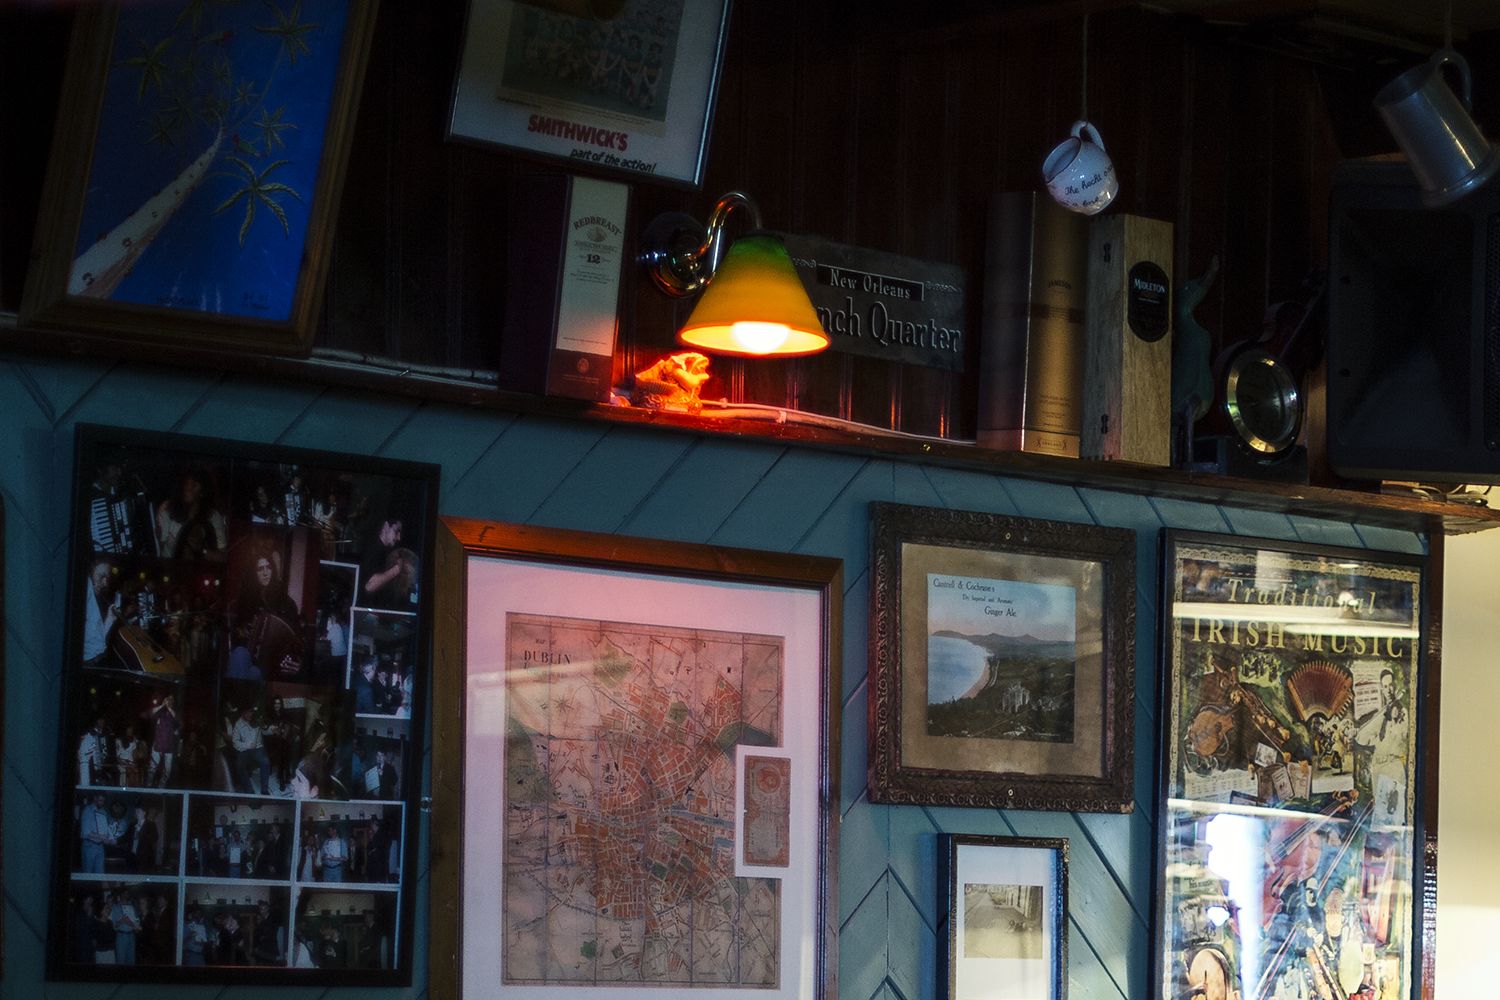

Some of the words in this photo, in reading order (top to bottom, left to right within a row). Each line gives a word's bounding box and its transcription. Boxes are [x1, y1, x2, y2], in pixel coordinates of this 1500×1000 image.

[527, 114, 629, 152] SMITHWICK'S
[570, 148, 592, 161] part
[592, 151, 606, 161] of
[604, 153, 620, 166] the
[620, 159, 657, 173] action!
[573, 215, 622, 236] REDBREAST
[587, 253, 601, 264] 12
[830, 268, 857, 290] New
[862, 274, 913, 300] Orleans
[817, 296, 862, 337] nch
[871, 301, 962, 353] Quarter
[1227, 578, 1376, 615] Traditional
[1006, 608, 1017, 617] Ale
[1191, 616, 1286, 649] IRISH
[1303, 633, 1403, 658] MUSIC
[524, 649, 573, 665] DUBLIN
